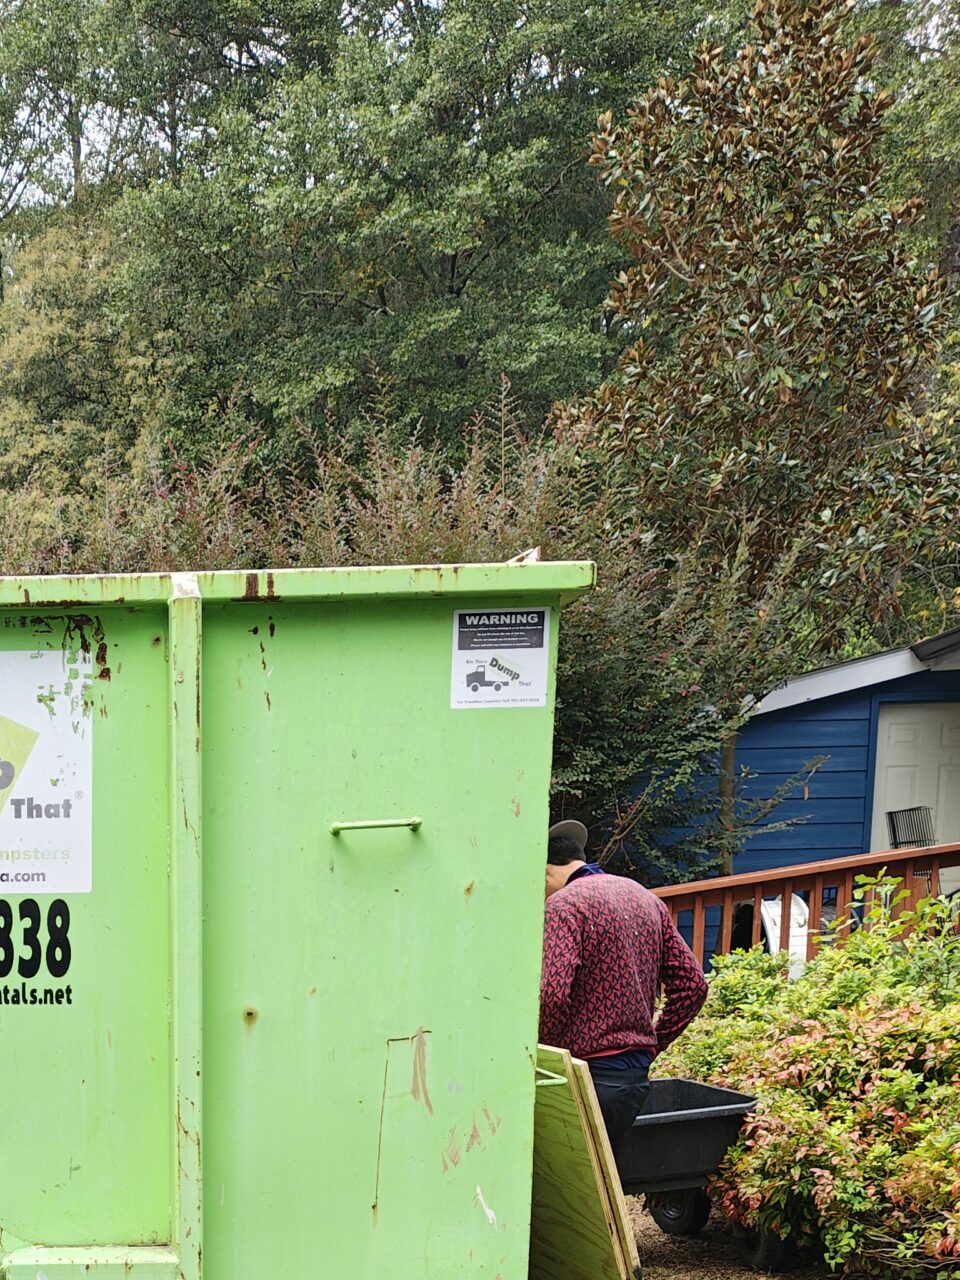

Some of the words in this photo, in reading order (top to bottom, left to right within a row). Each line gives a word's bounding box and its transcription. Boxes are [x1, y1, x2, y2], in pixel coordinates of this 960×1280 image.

[465, 614, 538, 625] WARNING
[489, 656, 520, 681] Dump
[10, 797, 73, 819] That
